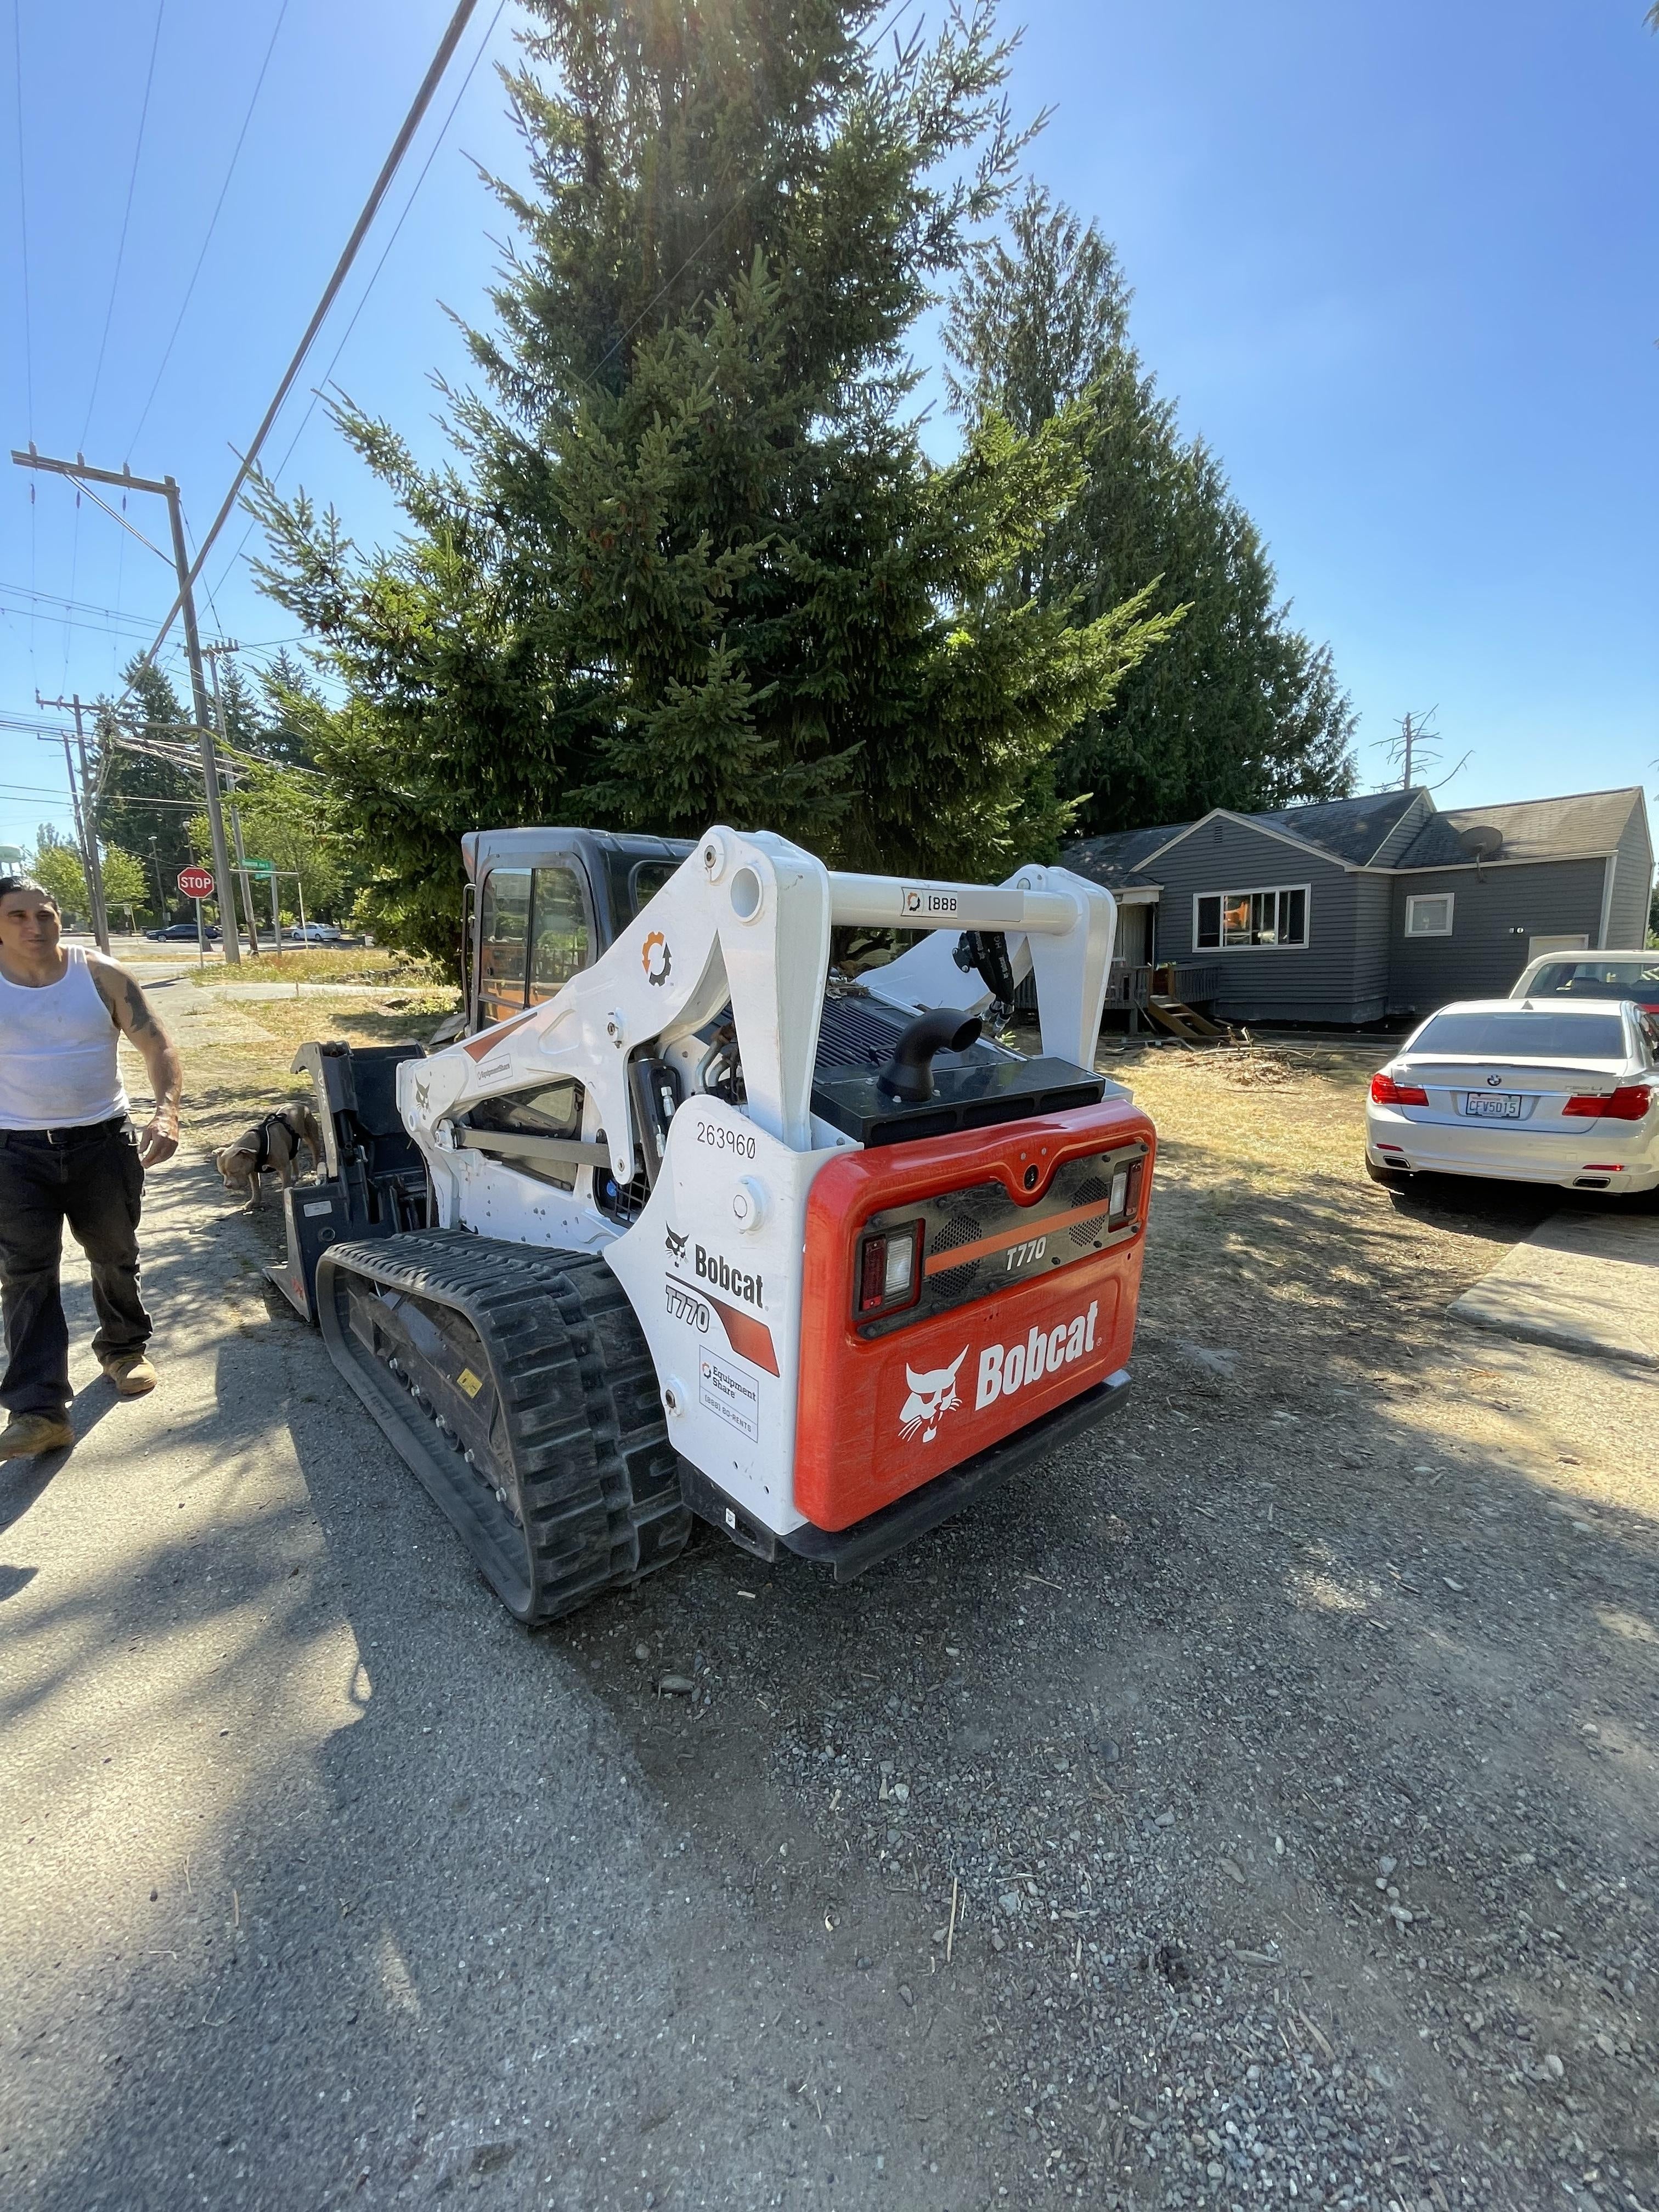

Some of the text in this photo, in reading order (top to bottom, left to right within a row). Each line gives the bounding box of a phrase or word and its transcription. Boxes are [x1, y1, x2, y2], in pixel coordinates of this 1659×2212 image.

[181, 877, 211, 889] STOP
[697, 1122, 755, 1159] 263960
[1006, 1237, 1047, 1271] T770
[696, 1244, 763, 1308] Bobcat
[665, 1284, 710, 1333] T770
[975, 1300, 1098, 1411] Bobcat
[713, 1365, 756, 1402] Equipment
[713, 1376, 736, 1398] Share
